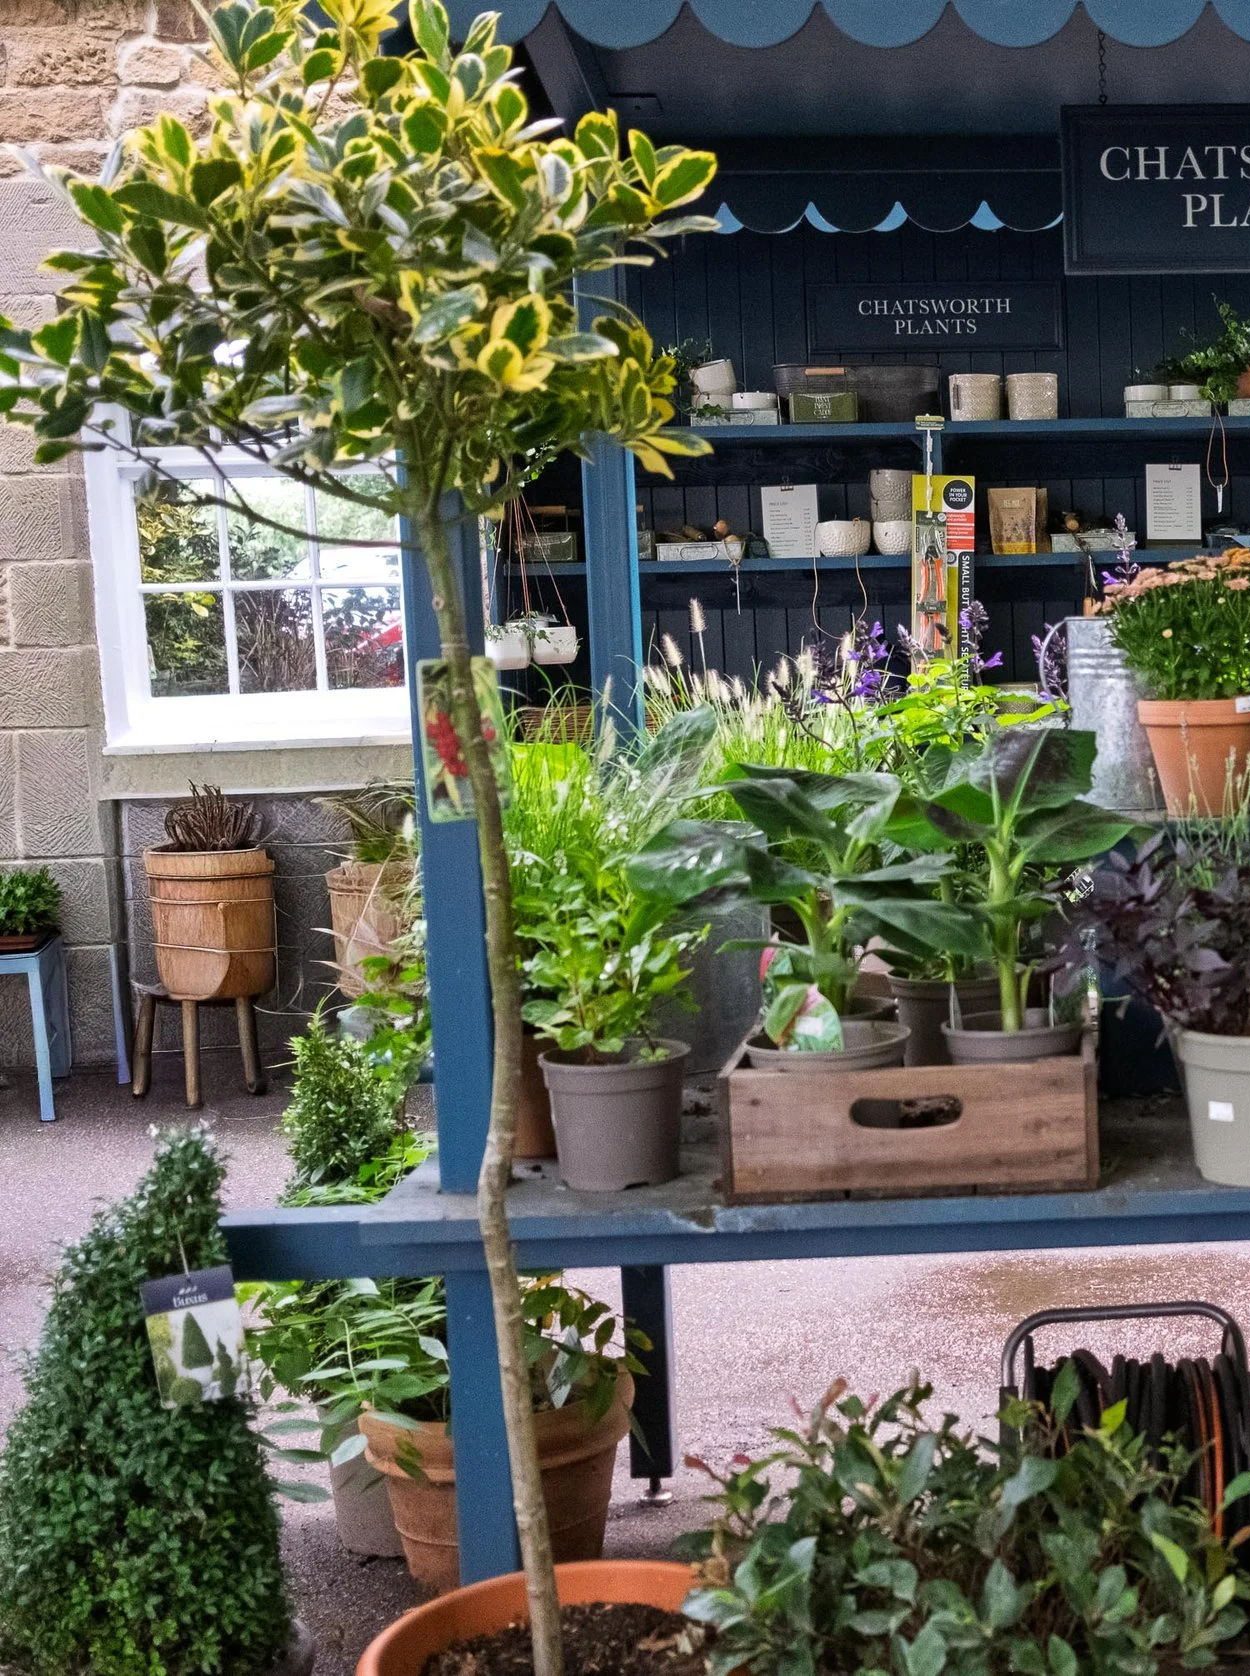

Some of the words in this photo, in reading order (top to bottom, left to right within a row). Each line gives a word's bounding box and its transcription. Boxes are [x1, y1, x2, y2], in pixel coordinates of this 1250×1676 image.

[858, 298, 1011, 315] CHATSWORTH
[894, 318, 977, 335] PLANTS
[961, 555, 970, 585] SMALL
[961, 587, 970, 606] BUT
